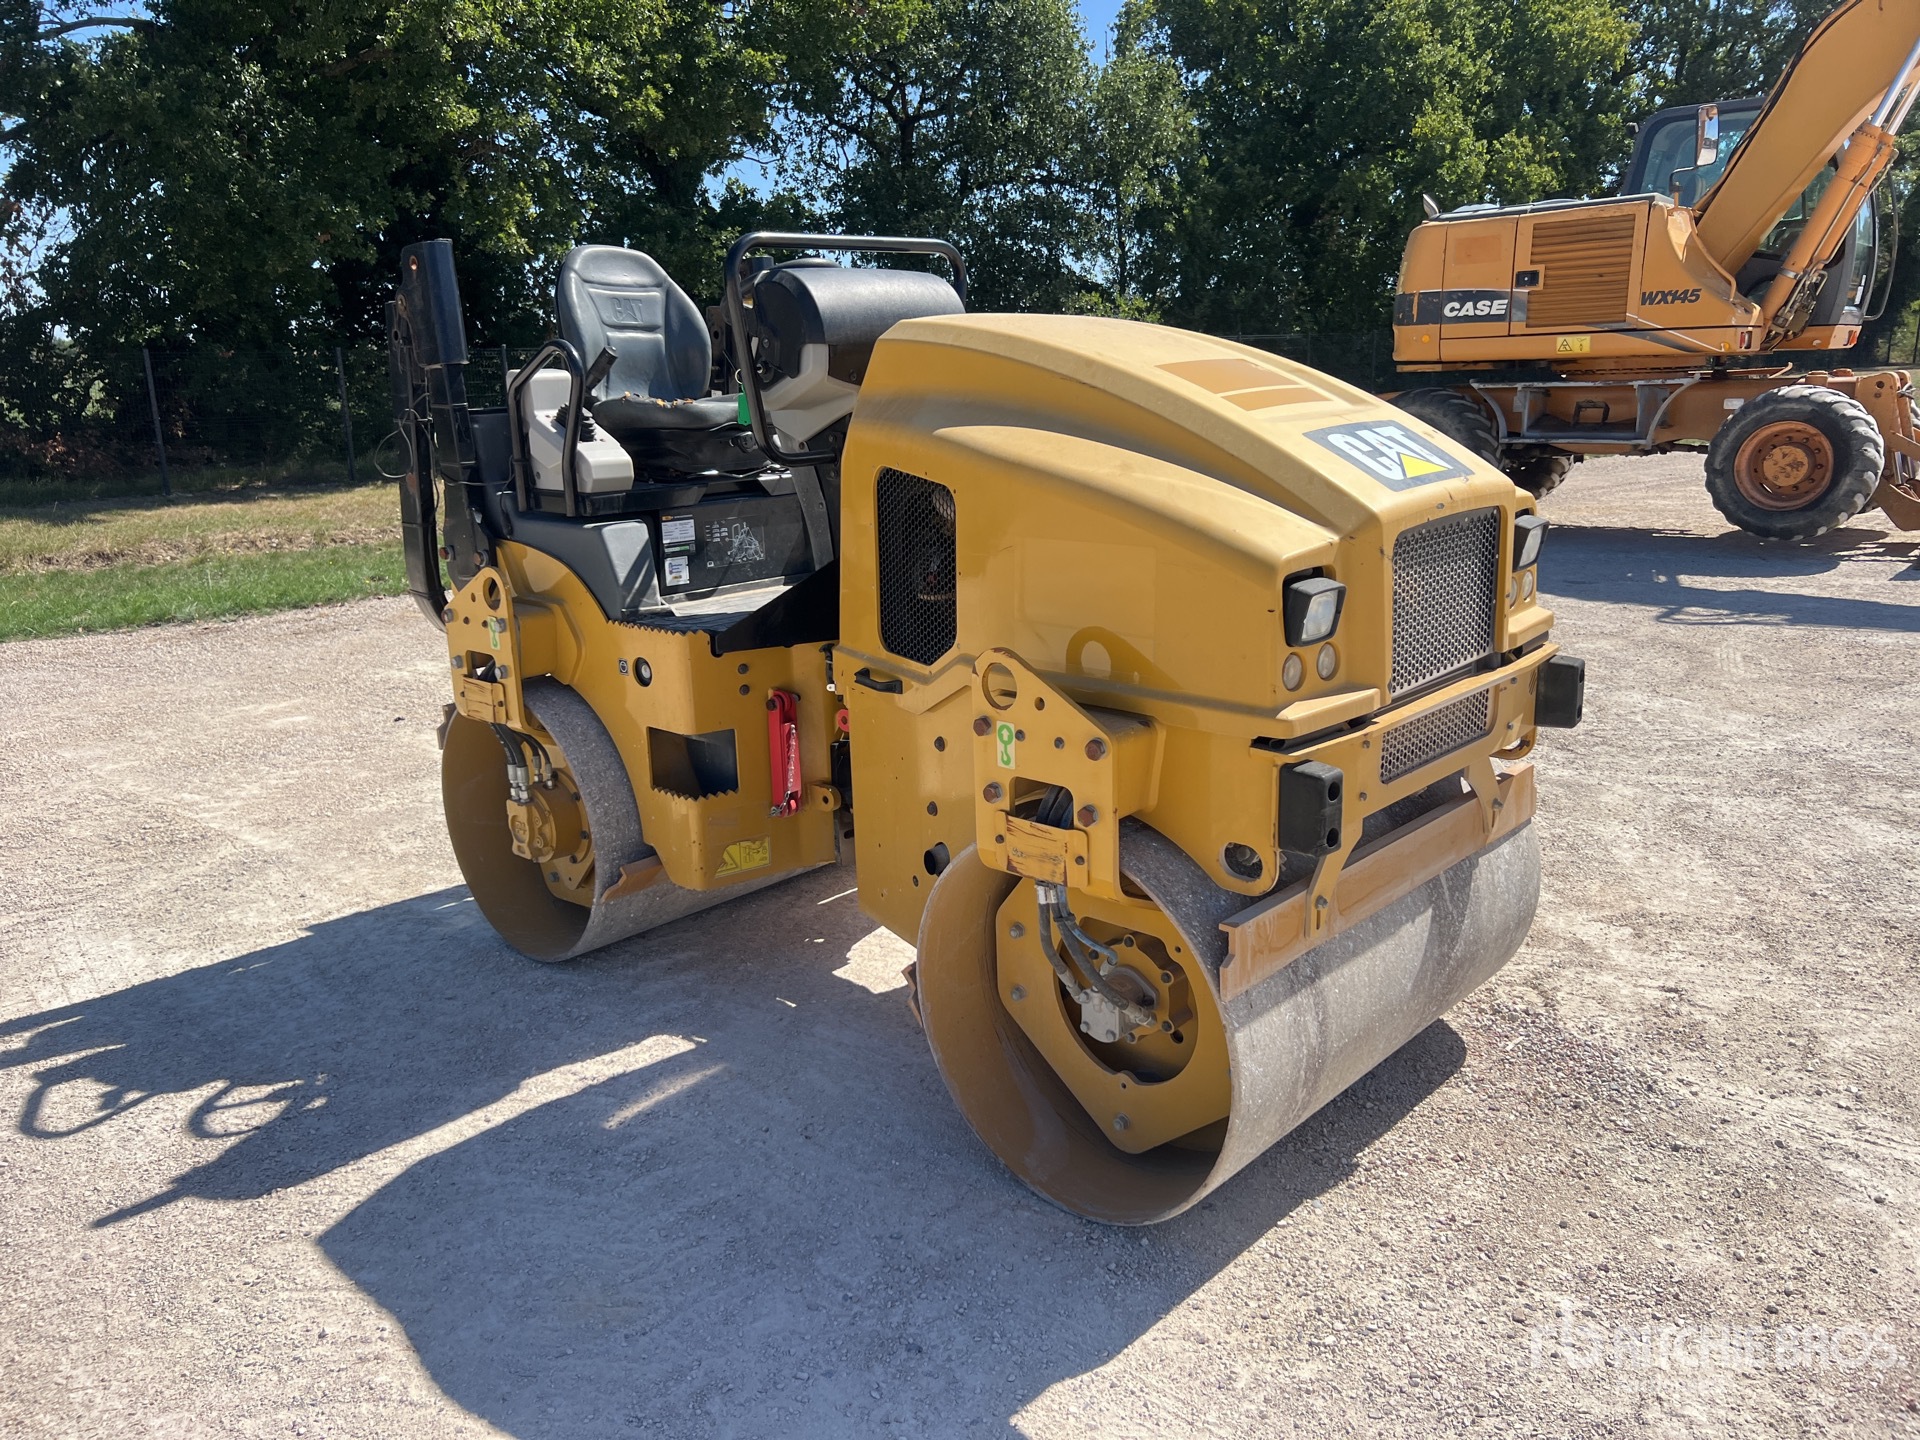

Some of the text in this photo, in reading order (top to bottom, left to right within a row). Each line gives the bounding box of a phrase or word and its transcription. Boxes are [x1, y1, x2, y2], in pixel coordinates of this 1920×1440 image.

[1443, 299, 1508, 318] CASE
[1640, 288, 1702, 306] WX145
[611, 297, 644, 324] CAT
[1327, 426, 1453, 481] CAT
